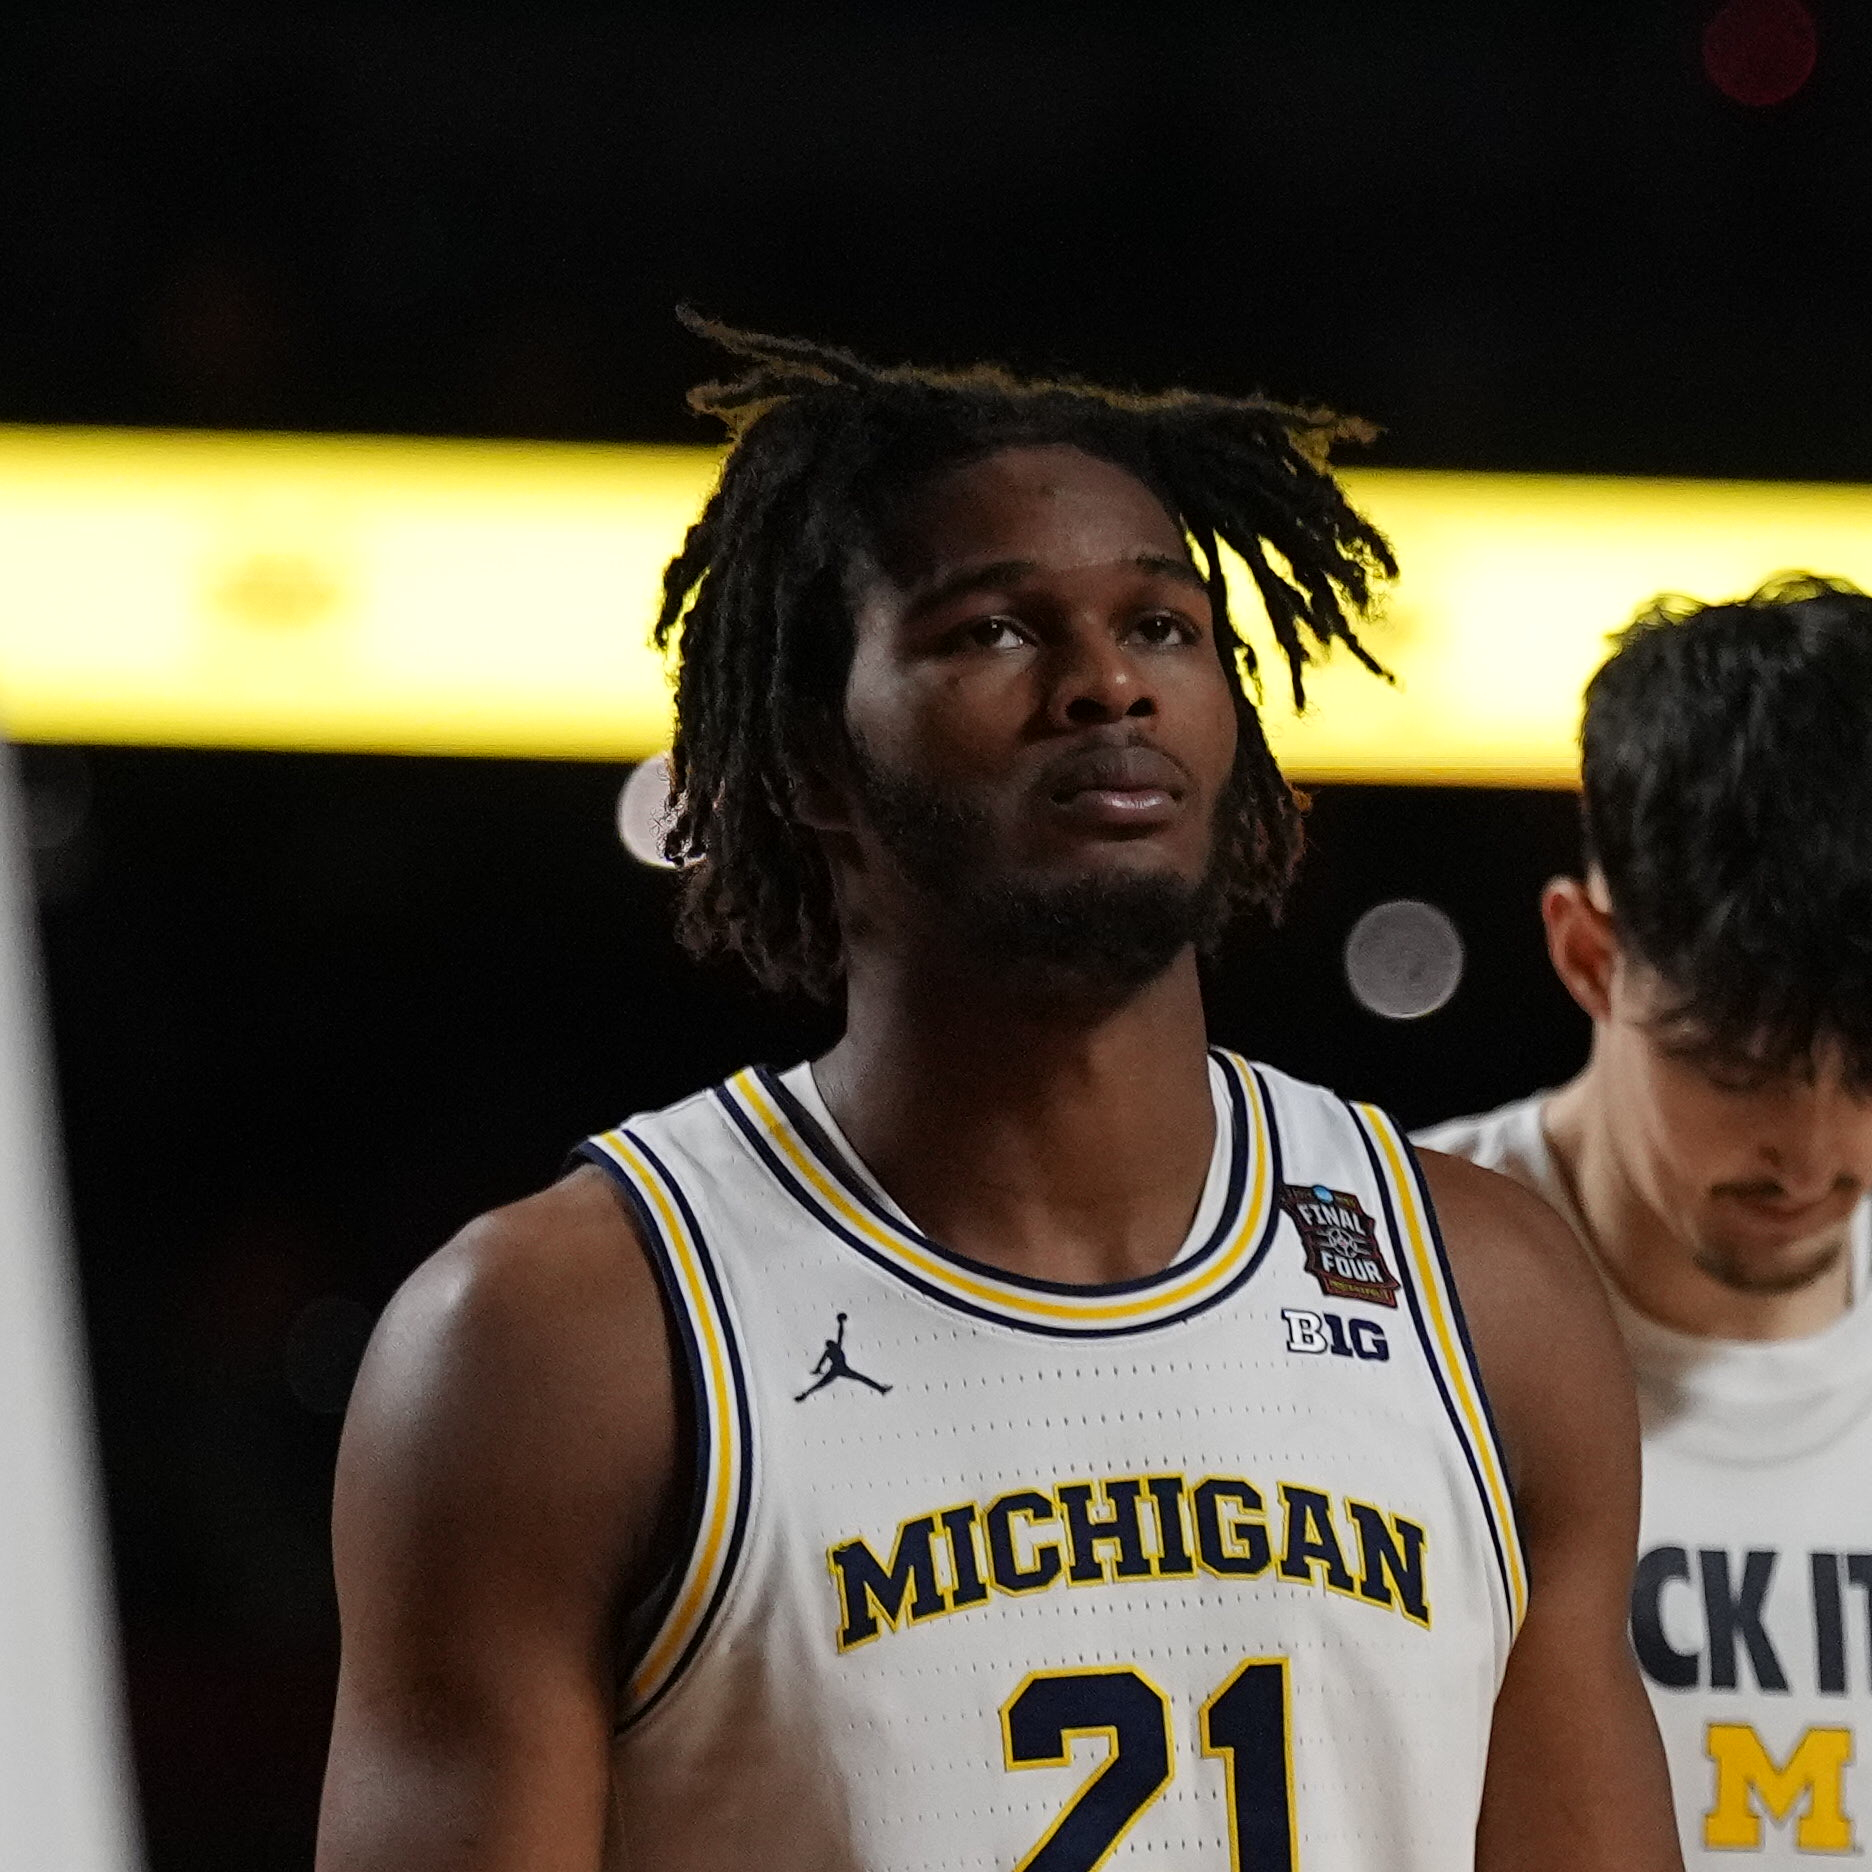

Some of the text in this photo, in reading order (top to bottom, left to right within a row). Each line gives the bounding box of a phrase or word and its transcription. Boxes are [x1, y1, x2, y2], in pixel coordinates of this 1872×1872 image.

[1297, 1203, 1367, 1235] FINAL
[1320, 1251, 1384, 1283] FOUR
[828, 1475, 1432, 1653] MICHIGAN
[1630, 1546, 1790, 1692] CK
[1703, 1721, 1853, 1855] M
